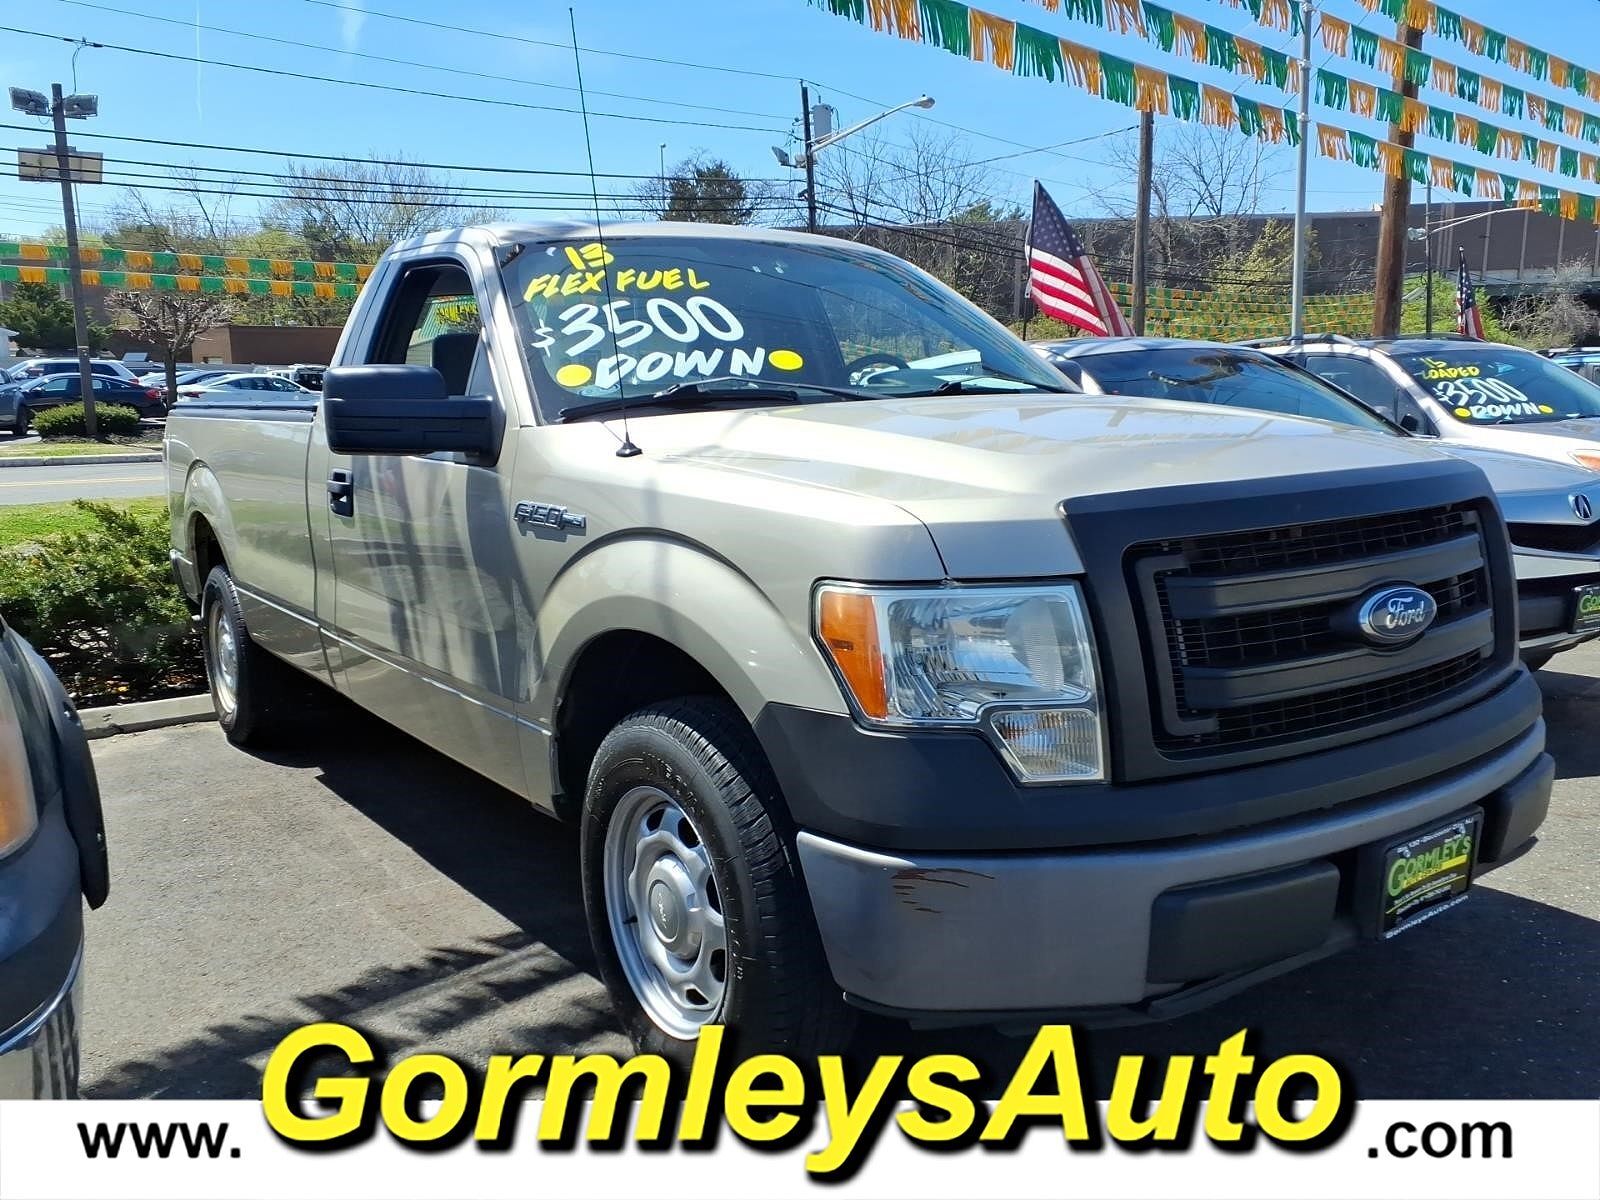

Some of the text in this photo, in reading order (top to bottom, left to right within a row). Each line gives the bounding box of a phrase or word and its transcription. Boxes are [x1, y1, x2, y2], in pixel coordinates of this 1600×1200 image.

[523, 268, 710, 302] FLEX FUEL
[531, 296, 745, 358] $3500
[594, 346, 766, 389] DOWN
[1469, 401, 1541, 419] DOWN
[1386, 596, 1425, 629] Ford
